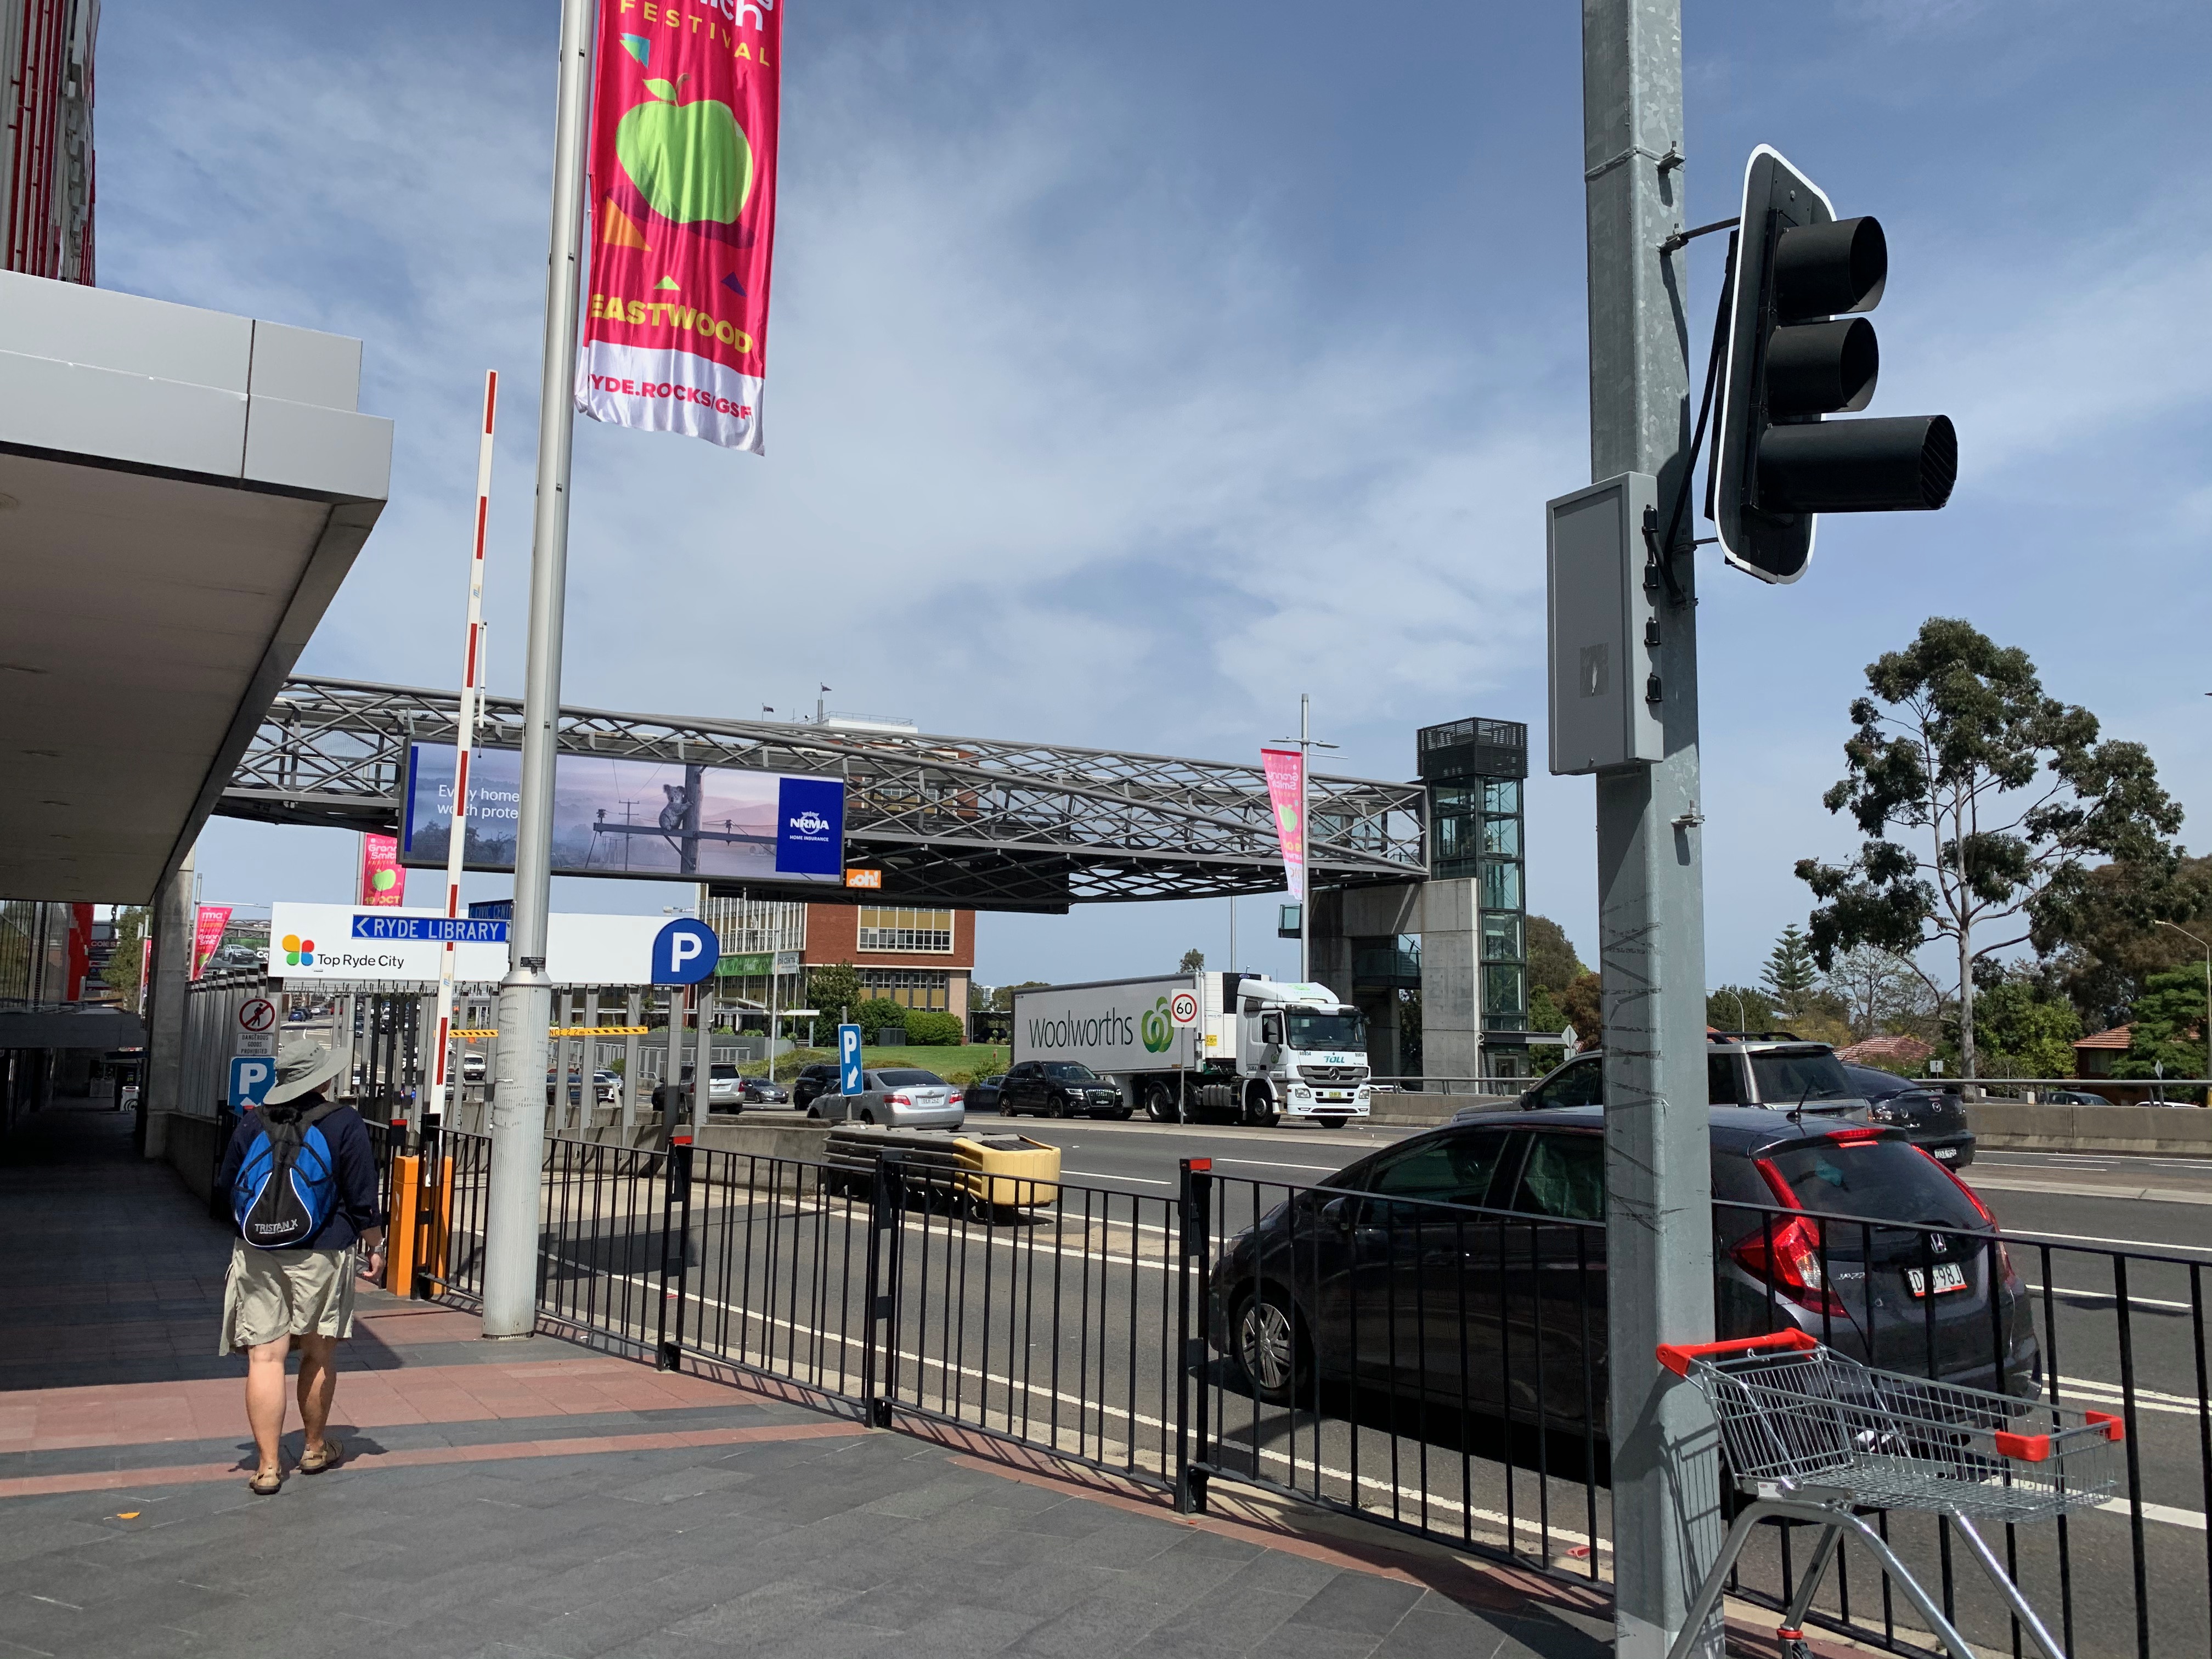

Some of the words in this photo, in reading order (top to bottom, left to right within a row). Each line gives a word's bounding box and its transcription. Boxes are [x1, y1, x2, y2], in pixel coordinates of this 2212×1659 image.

[620, 0, 770, 66] FESTIVAL
[591, 294, 753, 354] EASTWOOD
[588, 374, 752, 420] YDE.ROCKS/GSF
[439, 785, 477, 802] Evy
[481, 788, 520, 802] home
[790, 818, 830, 830] NRMA
[379, 895, 400, 904] OCT
[374, 919, 419, 938] RYDE
[428, 921, 499, 940] LIBRARY
[318, 954, 340, 967] Top
[343, 955, 376, 968] Ryde
[379, 955, 404, 969] City
[672, 932, 702, 972] P
[1176, 1002, 1192, 1014] 60
[1029, 1007, 1133, 1048] Woolworths
[843, 1031, 857, 1064] P
[239, 1063, 267, 1094] P
[255, 1221, 290, 1232] TRISTAN
[291, 1219, 298, 1228] X
